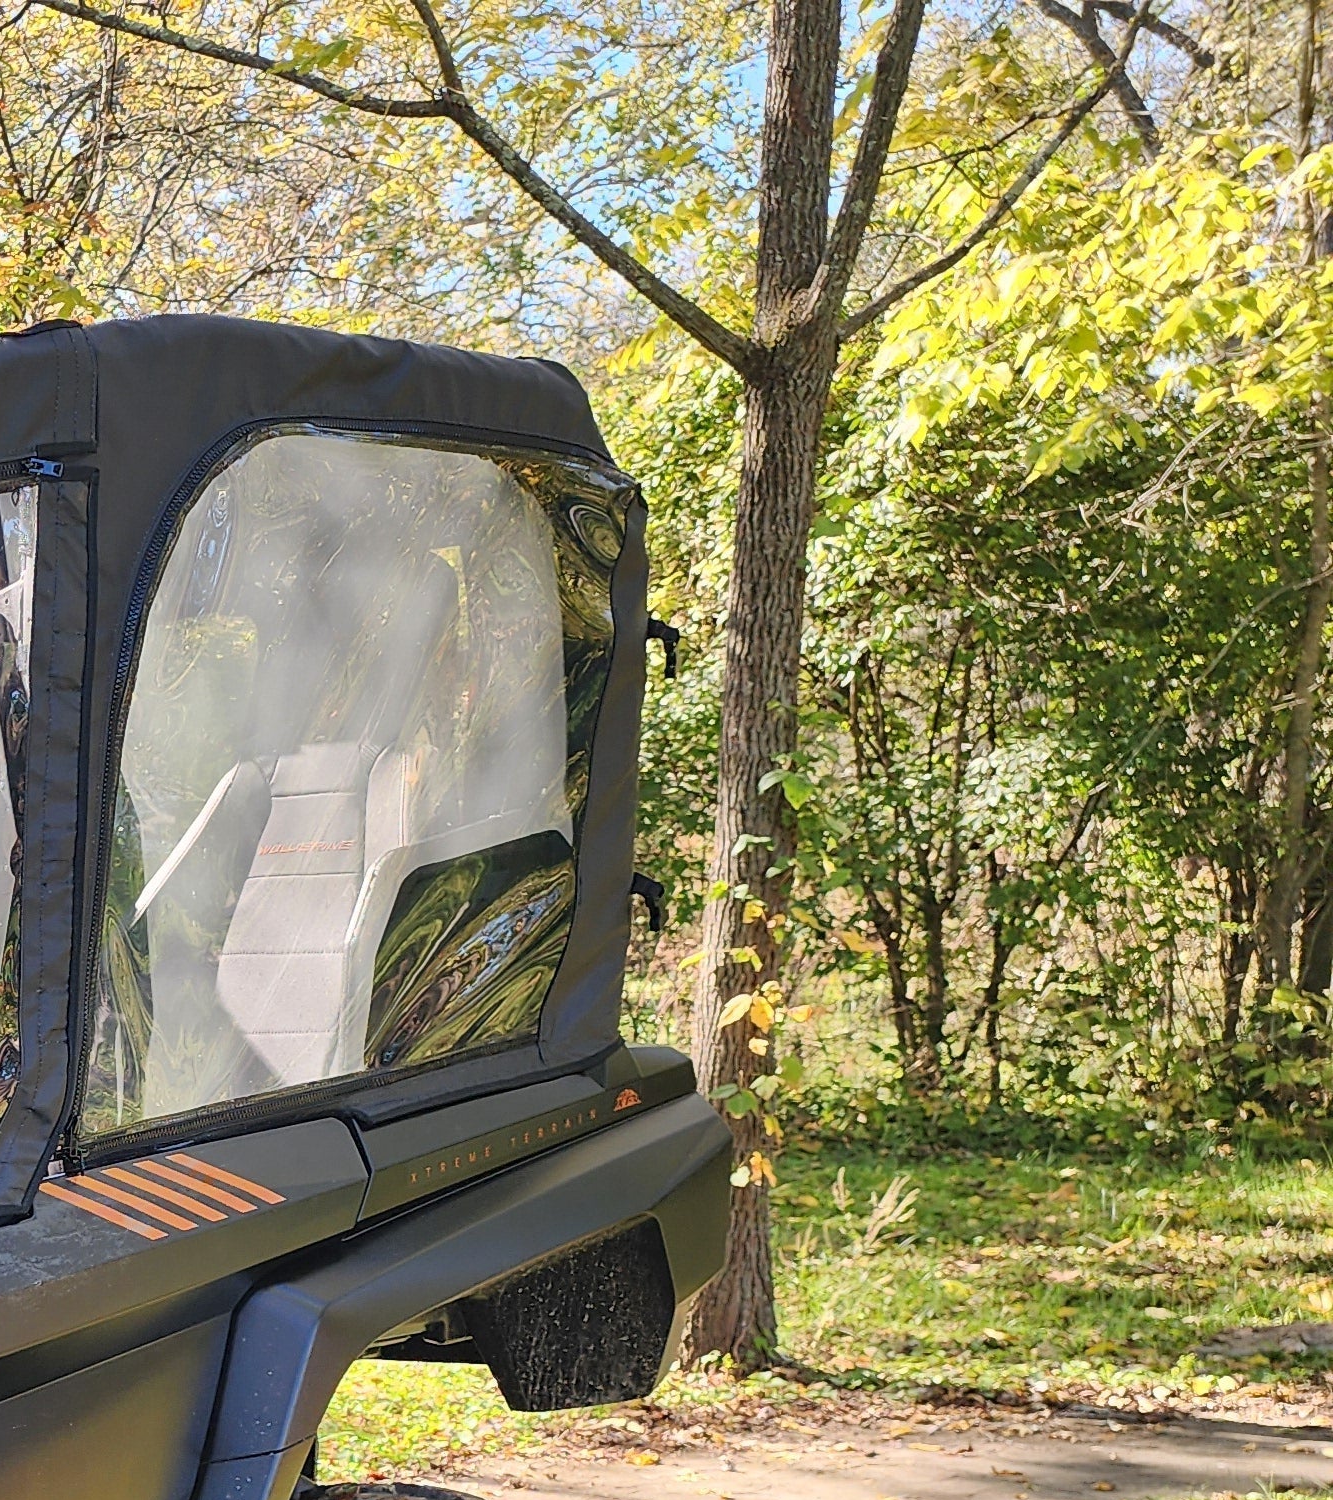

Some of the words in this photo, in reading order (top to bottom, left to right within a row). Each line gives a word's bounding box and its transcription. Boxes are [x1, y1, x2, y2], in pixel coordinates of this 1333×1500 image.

[258, 840, 356, 857] WOLVERINE
[410, 1145, 492, 1184] XTREME
[510, 1108, 597, 1147] TERRAIN
